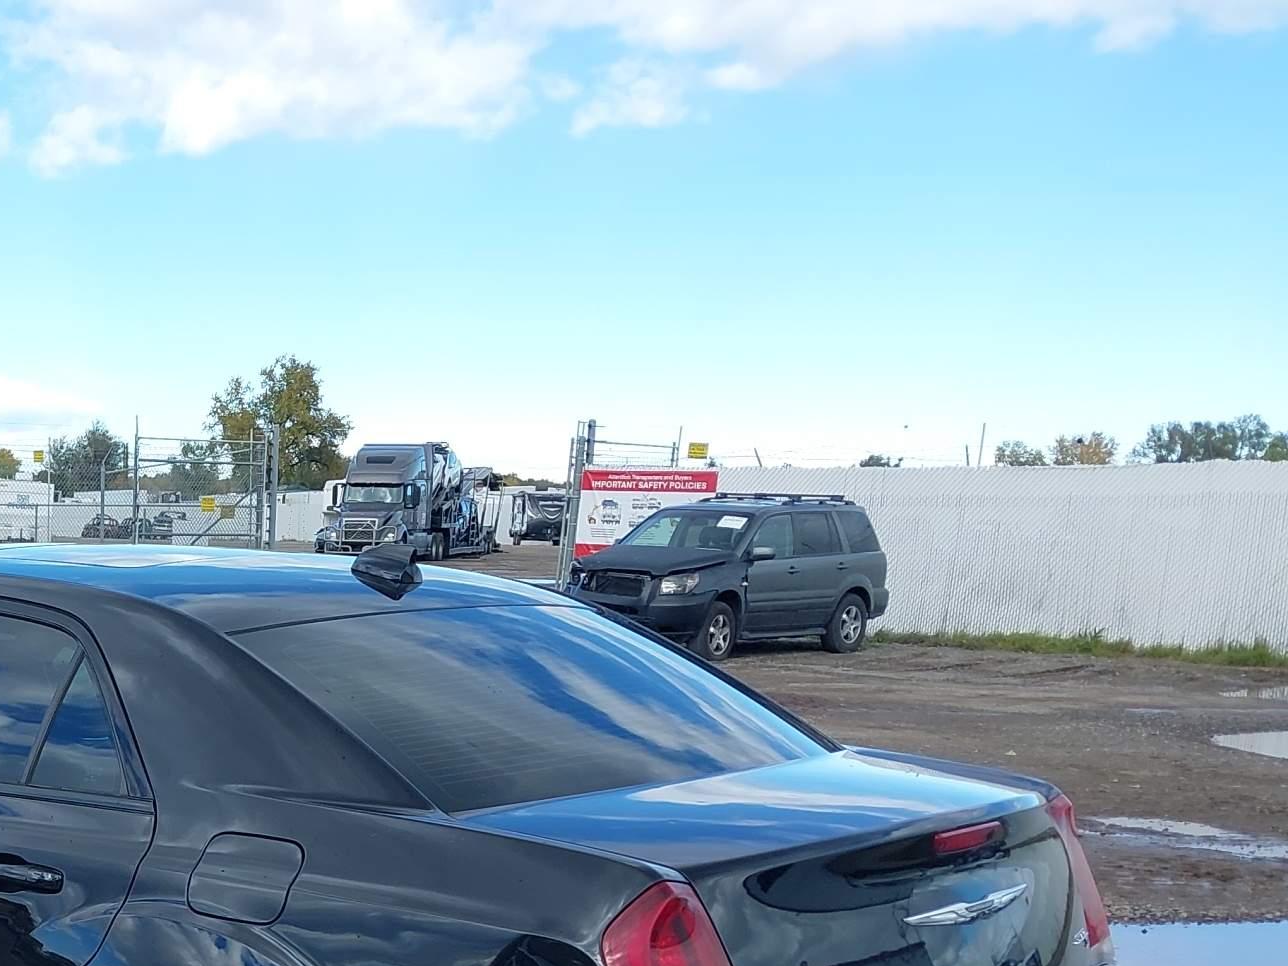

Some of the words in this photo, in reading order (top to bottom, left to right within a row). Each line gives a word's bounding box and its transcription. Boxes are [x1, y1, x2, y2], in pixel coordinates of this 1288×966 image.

[591, 480, 636, 489] IMPORTANT
[638, 481, 667, 489] SAFETY
[669, 481, 707, 490] POLICIES
